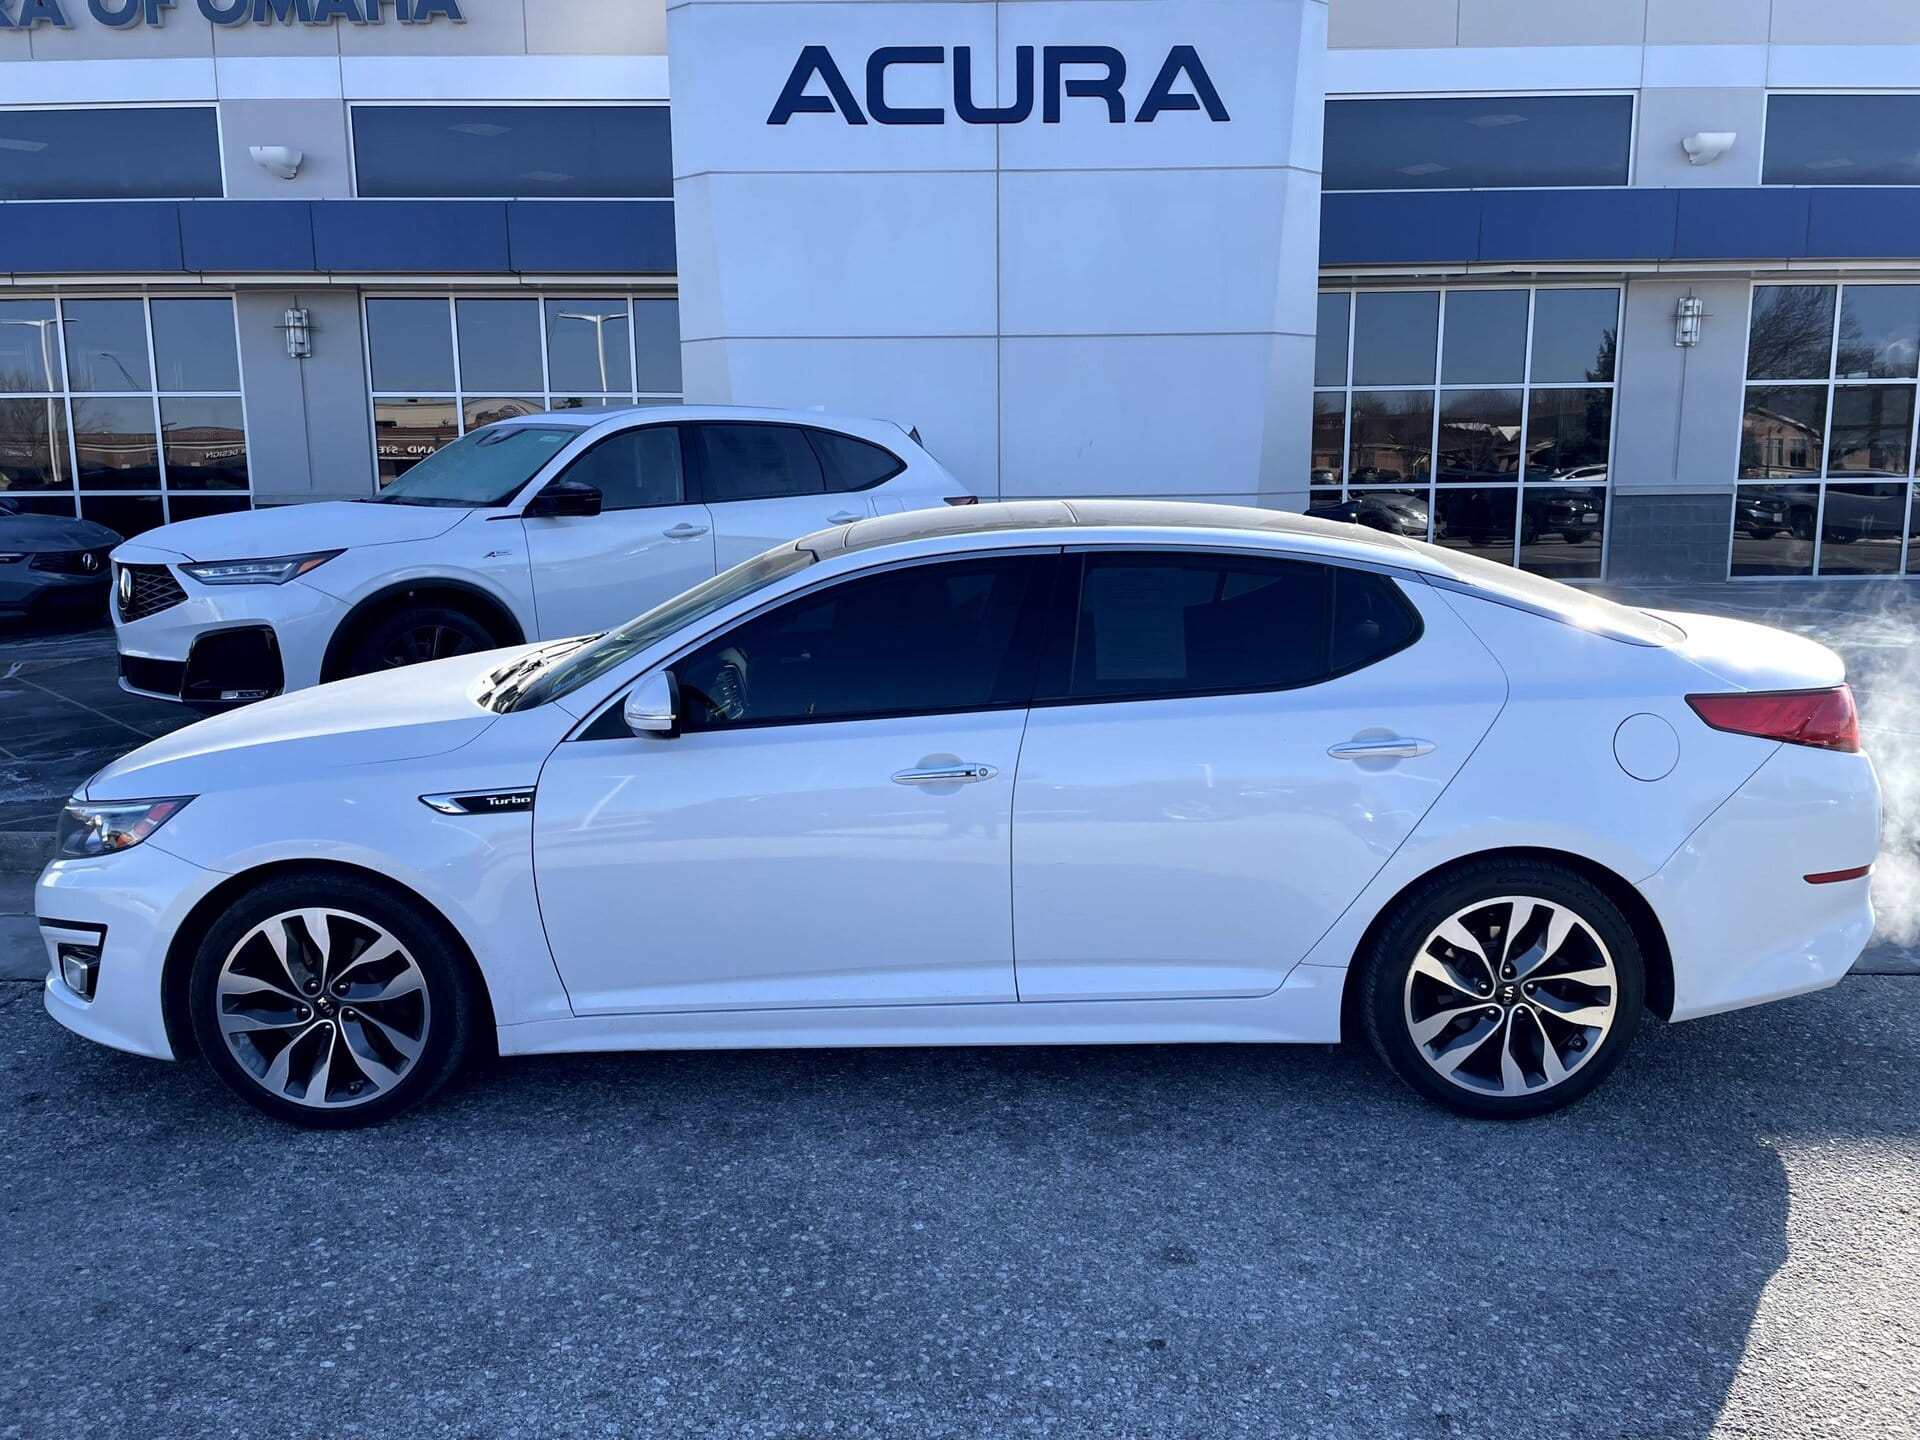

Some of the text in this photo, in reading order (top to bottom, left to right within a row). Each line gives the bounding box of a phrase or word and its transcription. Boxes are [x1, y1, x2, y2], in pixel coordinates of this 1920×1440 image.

[766, 45, 1231, 125] ACURA
[486, 796, 531, 806] Turbo
[1502, 985, 1514, 1005] KIA
[317, 996, 334, 1016] KIA
